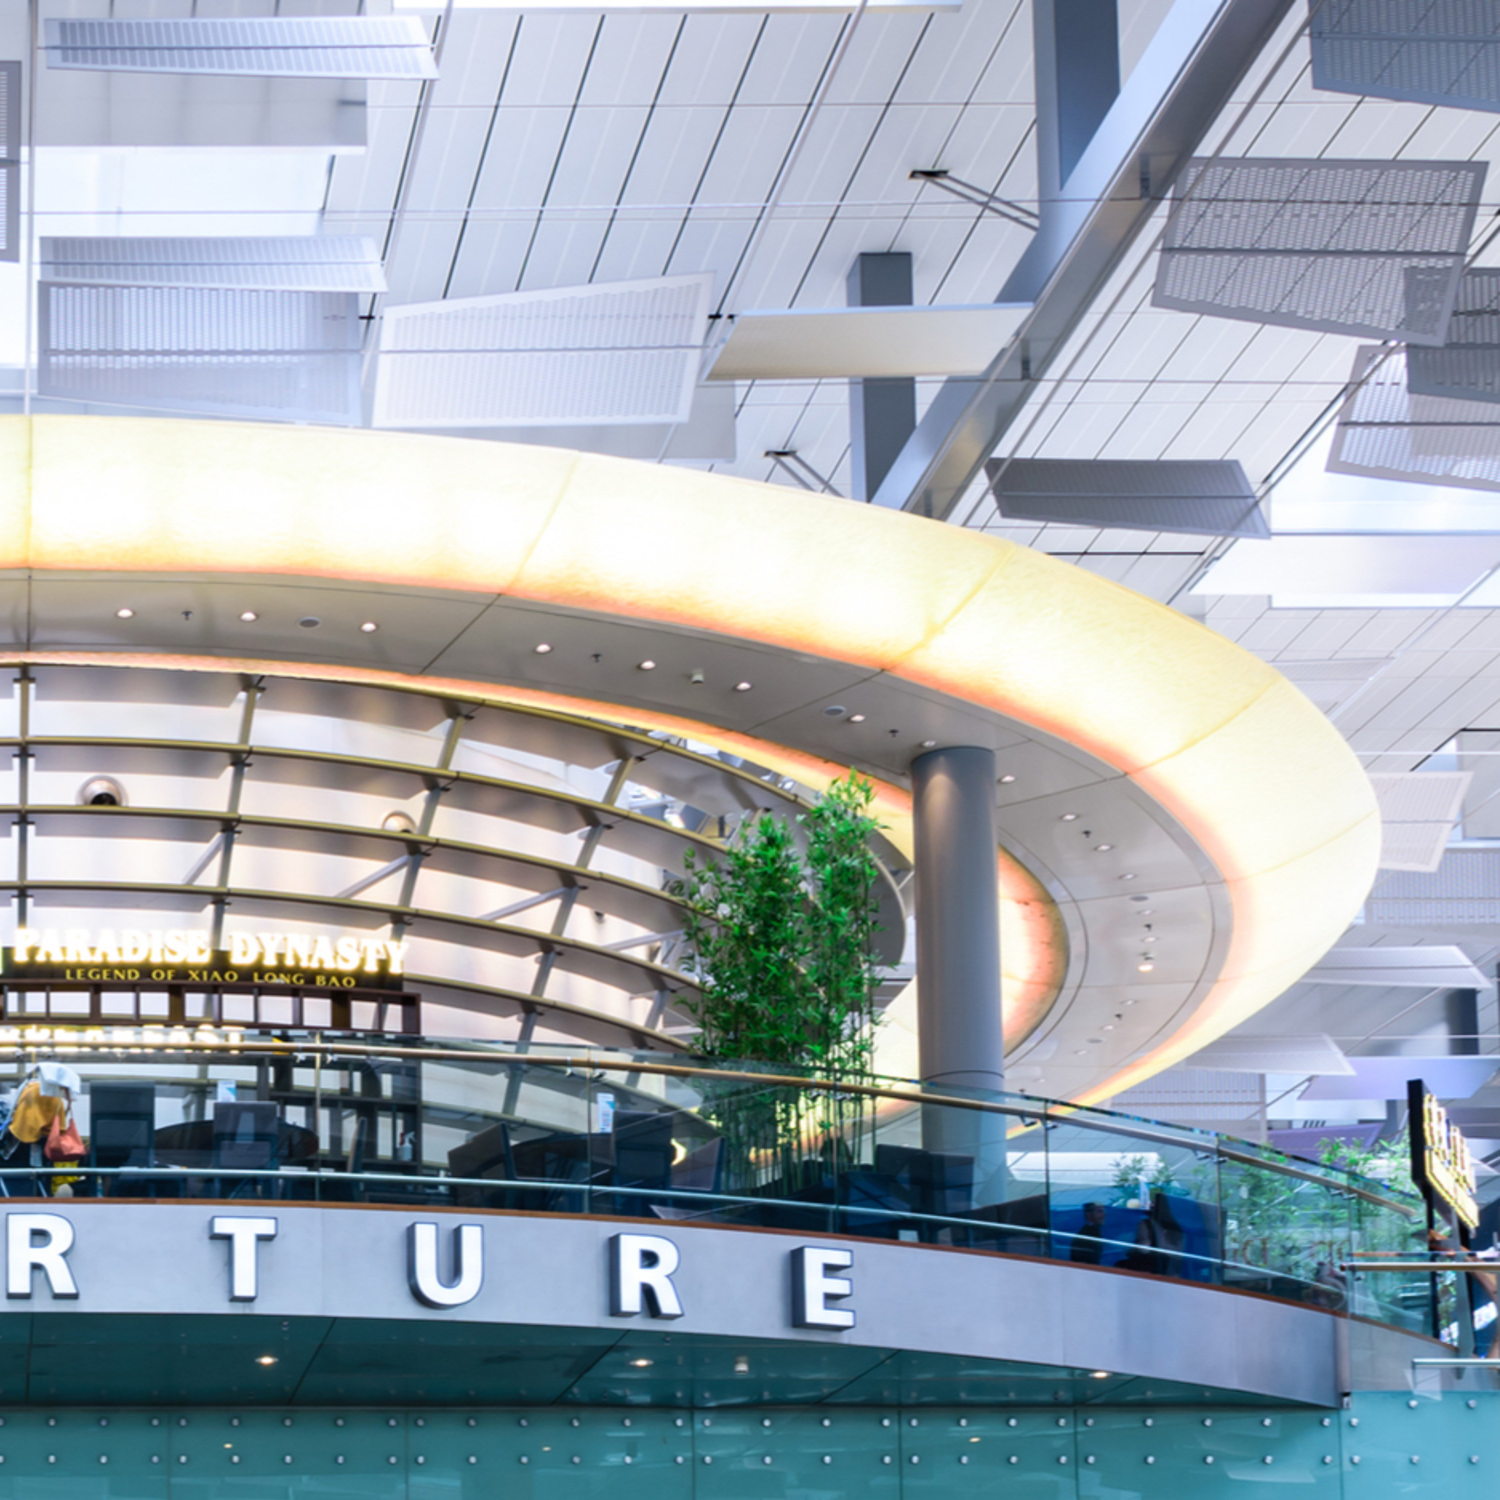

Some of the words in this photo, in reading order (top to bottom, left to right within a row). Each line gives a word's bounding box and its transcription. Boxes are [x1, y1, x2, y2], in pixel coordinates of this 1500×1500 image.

[12, 926, 211, 964] PARADISE
[228, 930, 410, 974] DYNASTY
[65, 968, 140, 982] LEGEND
[151, 968, 177, 982] OF
[187, 968, 239, 983] XIAO
[253, 970, 305, 986] LONG
[315, 973, 357, 989] BAO
